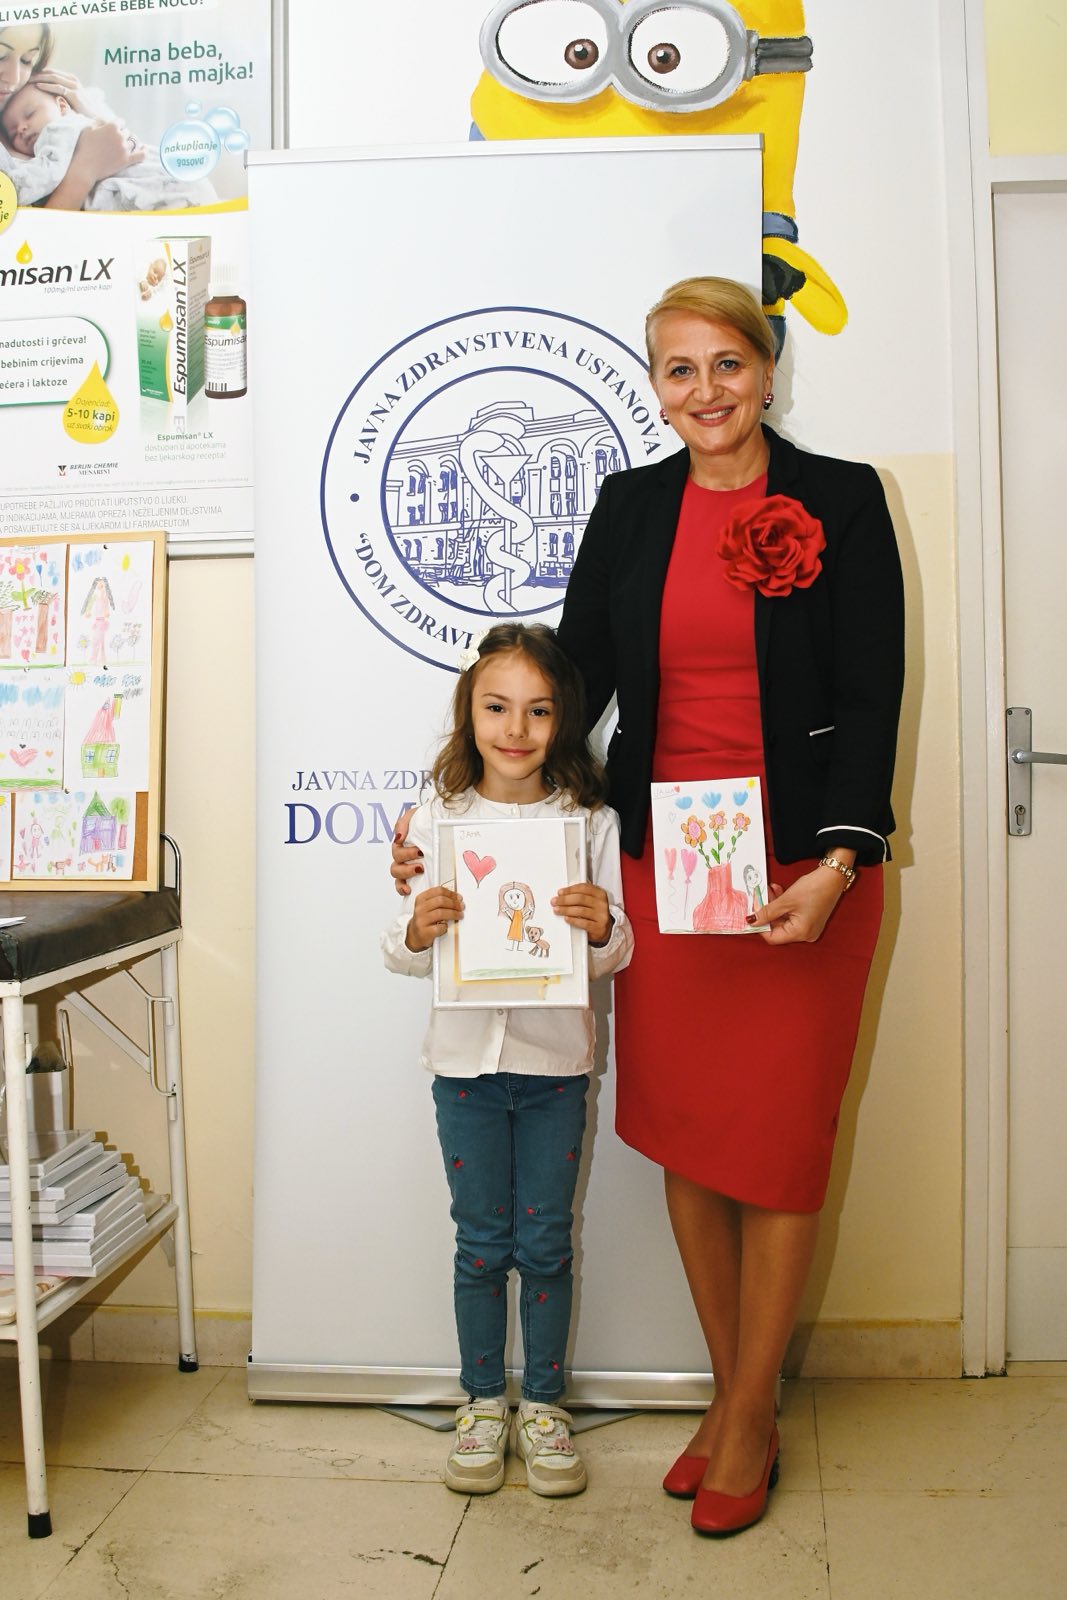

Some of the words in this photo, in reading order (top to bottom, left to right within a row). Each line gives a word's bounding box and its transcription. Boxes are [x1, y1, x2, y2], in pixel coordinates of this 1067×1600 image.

[14, 8, 40, 20] VAS
[43, 2, 78, 18] PLAČ
[120, 0, 155, 11] BEBE
[104, 47, 161, 65] Mirna
[168, 40, 223, 60] beba,
[125, 70, 181, 87] mirna
[188, 62, 253, 85] majka!
[164, 140, 218, 154] nakupljanje
[176, 157, 205, 167] gasova
[80, 257, 115, 282] LX
[173, 258, 187, 287] LX
[0, 337, 45, 348] nadutosti
[46, 337, 49, 346] i
[52, 336, 87, 347] grčeva!
[173, 291, 188, 395] Espumisan
[1, 359, 38, 368] bebinim
[41, 356, 84, 367] crijevima
[27, 379, 30, 387] i
[33, 378, 68, 388] laktoze
[353, 391, 402, 464] JAVNA
[396, 331, 569, 393] ZDRAVSTVENA
[575, 348, 662, 456] USTANOVA
[67, 408, 90, 419] 5-10
[92, 410, 115, 423] kapi
[93, 424, 113, 432] obrok
[203, 431, 214, 439] LX
[145, 443, 178, 453] dostupan
[187, 442, 226, 451] apotekama
[144, 454, 158, 462] bez
[160, 453, 195, 463] ljekarskog
[1, 501, 37, 511] UPOTREBE
[40, 499, 73, 509] PAŽLJIVO
[75, 498, 113, 508] PROČITATI
[114, 496, 153, 506] UPUTSTVO
[154, 496, 160, 505] O
[61, 511, 96, 520] MJERAMA
[98, 510, 127, 519] OPREZA
[133, 506, 179, 517] NEŽELJENIM
[180, 505, 223, 516] DEJSTVIMA
[4, 524, 58, 534] POSAVJETUJTE
[60, 523, 70, 532] SE
[71, 522, 80, 531] SA
[82, 521, 121, 531] LJEKAROM
[133, 519, 190, 529] FARMACEUTOM
[291, 770, 378, 791] JAVNA
[284, 801, 417, 845] DOM
